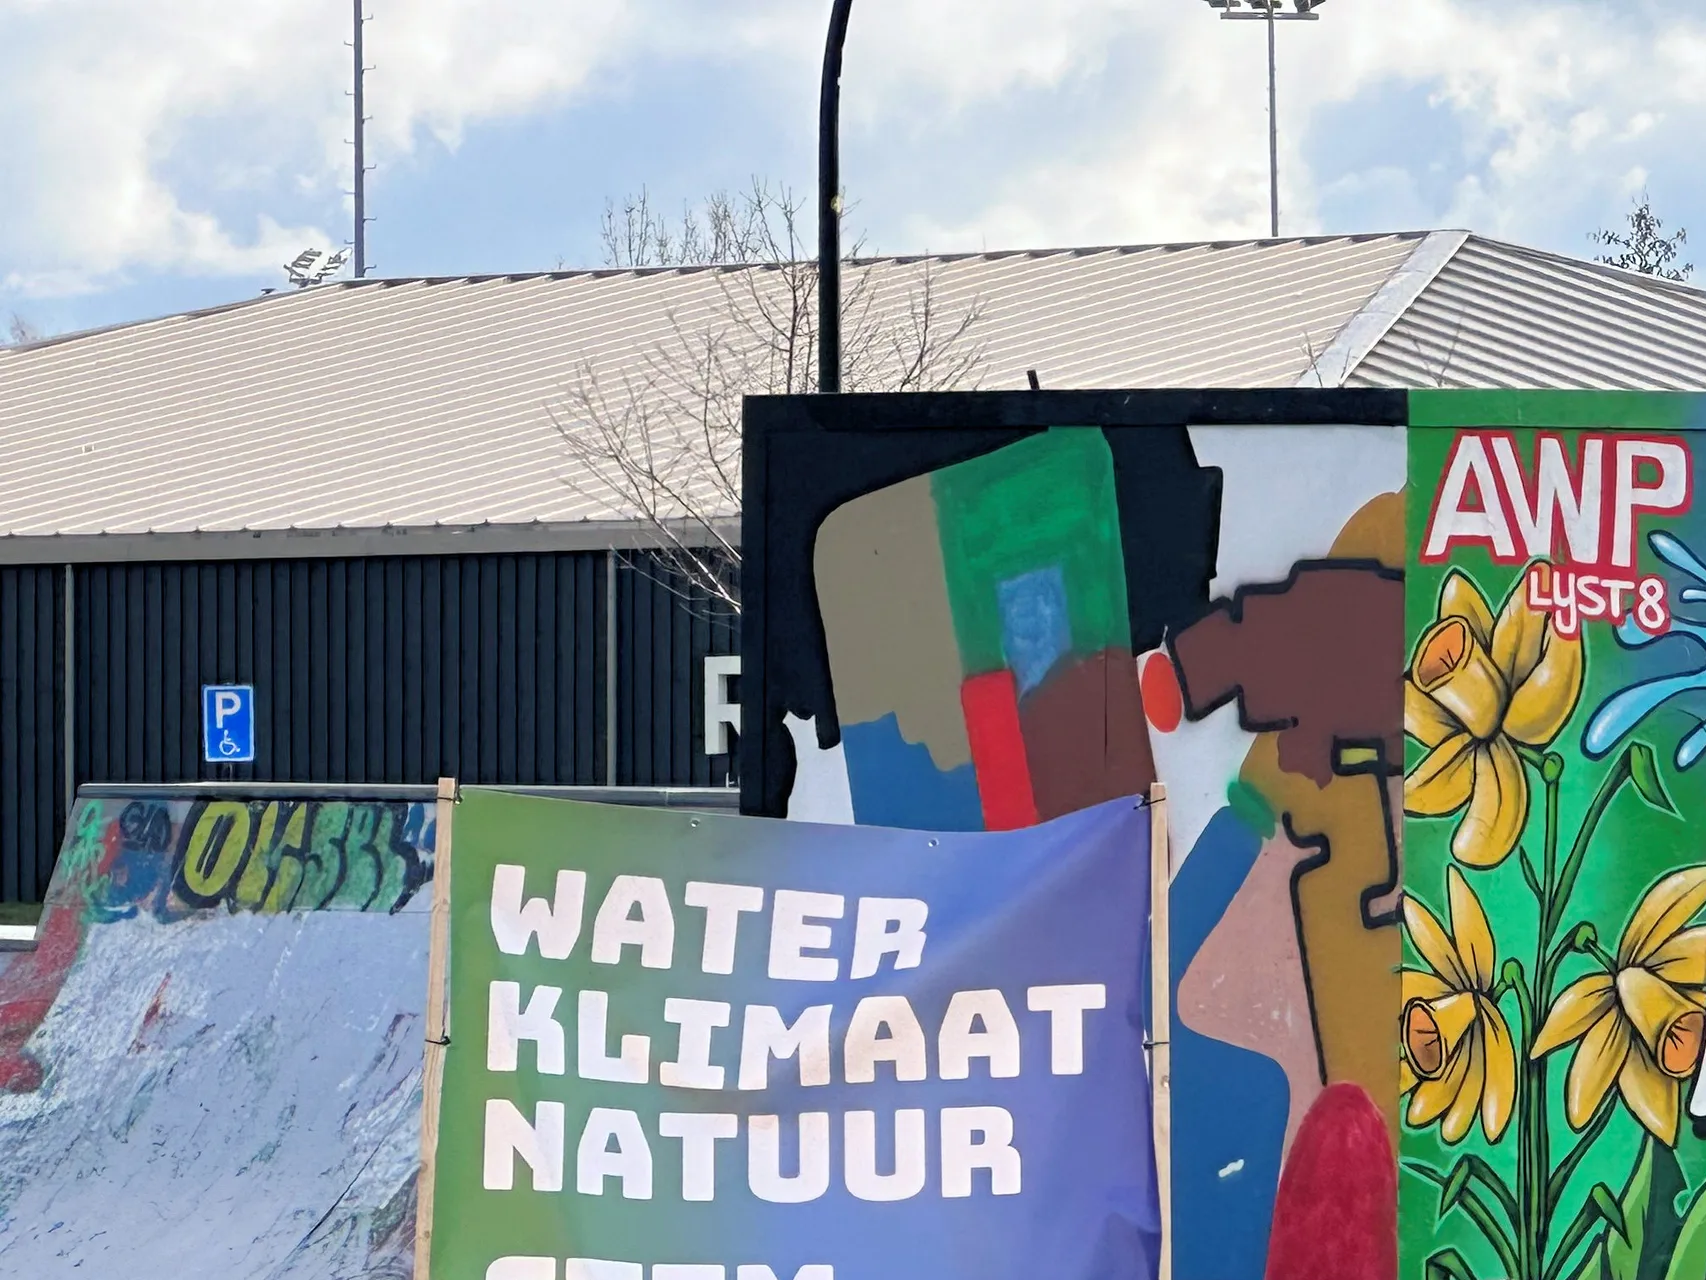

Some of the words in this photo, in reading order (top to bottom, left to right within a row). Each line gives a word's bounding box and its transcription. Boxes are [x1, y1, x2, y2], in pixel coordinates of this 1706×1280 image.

[1421, 431, 1692, 569] AWP
[1636, 577, 1666, 629] 8
[216, 691, 242, 728] P
[489, 863, 930, 982] WATER
[486, 980, 1107, 1091] KLIMAAT
[482, 1098, 1023, 1203] NATUUR
